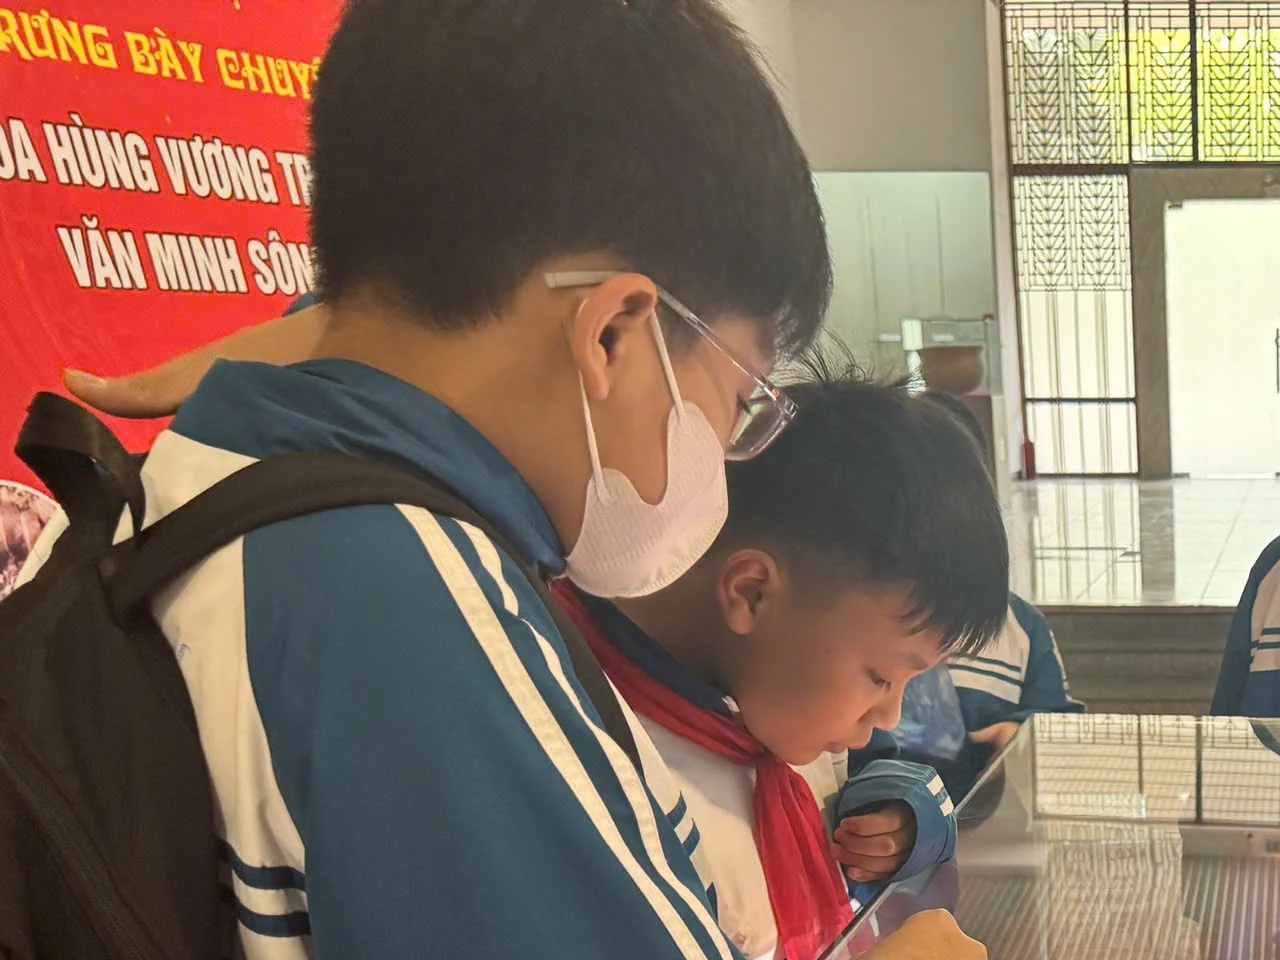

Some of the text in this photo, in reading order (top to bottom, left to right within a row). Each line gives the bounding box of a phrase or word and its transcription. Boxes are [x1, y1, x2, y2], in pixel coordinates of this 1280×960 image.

[124, 27, 204, 83] BÀY
[42, 111, 160, 194] HÙNG
[155, 134, 279, 205] VƯƠNG
[56, 214, 147, 290] VĂN
[145, 232, 249, 293] MINH
